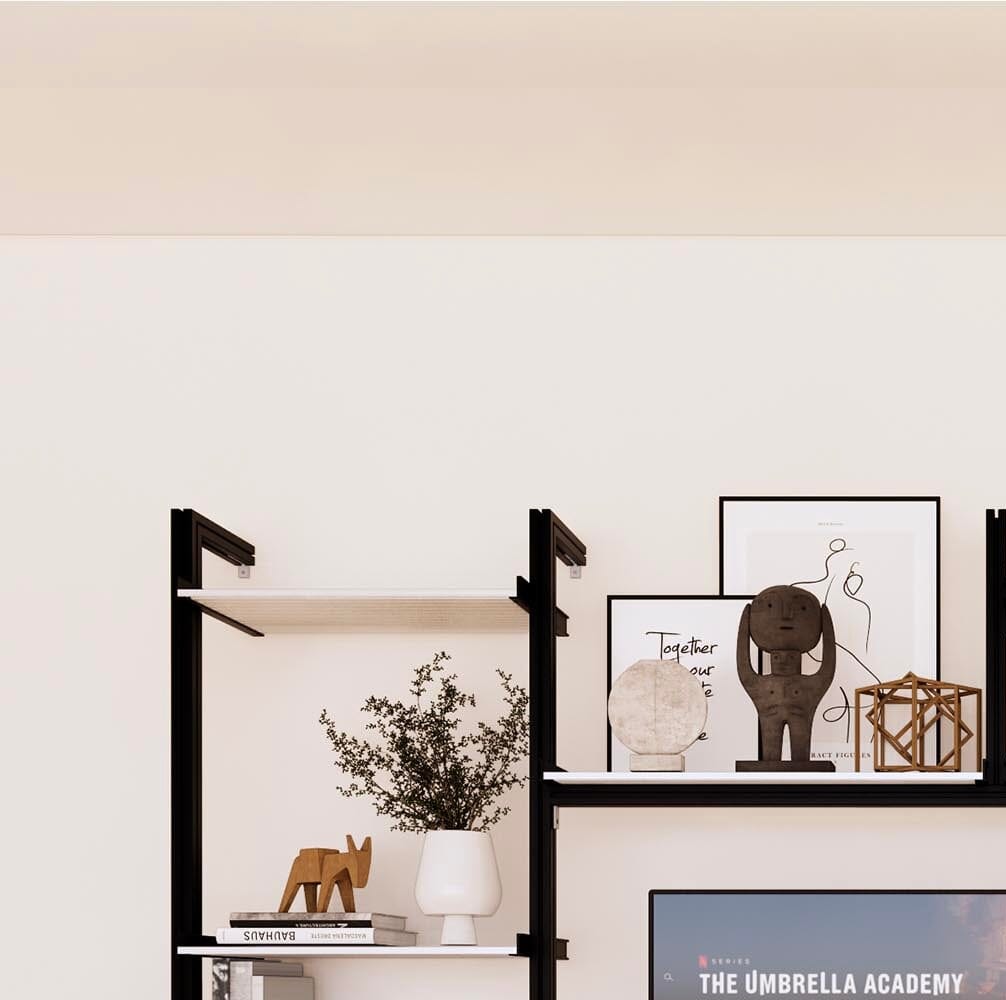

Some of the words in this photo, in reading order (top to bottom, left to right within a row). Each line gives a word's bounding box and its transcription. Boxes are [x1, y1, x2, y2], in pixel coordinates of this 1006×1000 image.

[646, 632, 718, 664] Together
[244, 931, 296, 941] BAUHAUS
[699, 972, 738, 994] THE
[745, 969, 857, 996] UMBRELLA
[864, 972, 964, 996] ACADEMY
